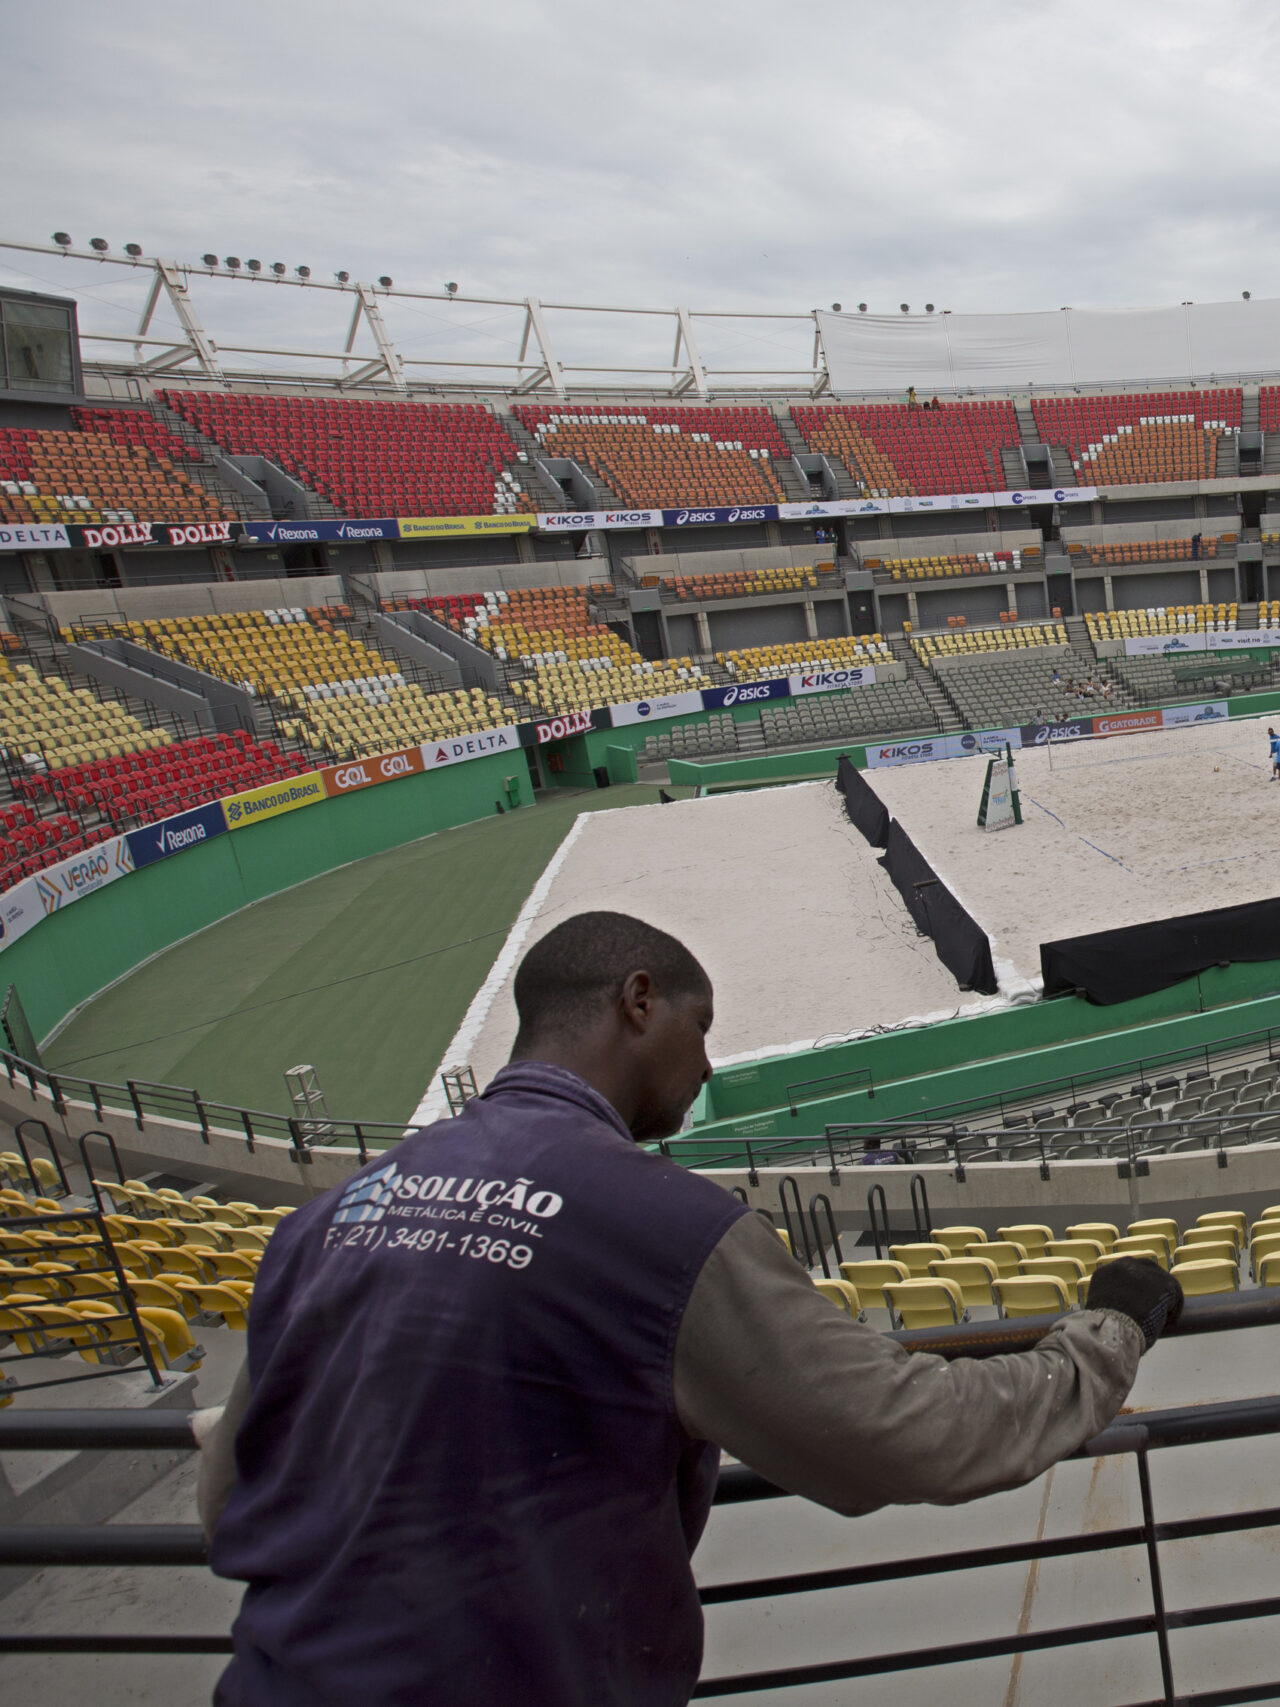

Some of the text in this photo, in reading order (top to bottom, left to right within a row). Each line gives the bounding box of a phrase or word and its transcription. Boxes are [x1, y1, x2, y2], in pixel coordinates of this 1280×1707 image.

[546, 515, 595, 525] KIKOS
[605, 512, 652, 523] KIKOS
[689, 512, 716, 522] asics
[740, 509, 766, 520] asics
[0, 530, 66, 543] DELTA
[82, 521, 153, 548] DOLLY
[168, 521, 231, 546] DOLLY
[278, 527, 319, 540] Rexona
[346, 526, 383, 538] Rexona
[801, 669, 863, 688] KIKOS
[739, 685, 770, 701] asics
[536, 711, 592, 744] DOLLY
[1051, 725, 1081, 739] asics
[1110, 716, 1157, 730] GATORADE
[452, 734, 508, 757] DELTA
[879, 743, 934, 759] KIKOS
[335, 754, 414, 788] GOL GOL
[243, 783, 321, 816] BANCO DO BRASIL
[166, 823, 207, 850] Rexona
[61, 855, 109, 892] VERÃO
[398, 1174, 564, 1219] SOLUÇÃO
[386, 1205, 467, 1222] METÁLICA
[487, 1213, 544, 1238] CIVIL
[387, 1227, 534, 1270] 3491-1369
